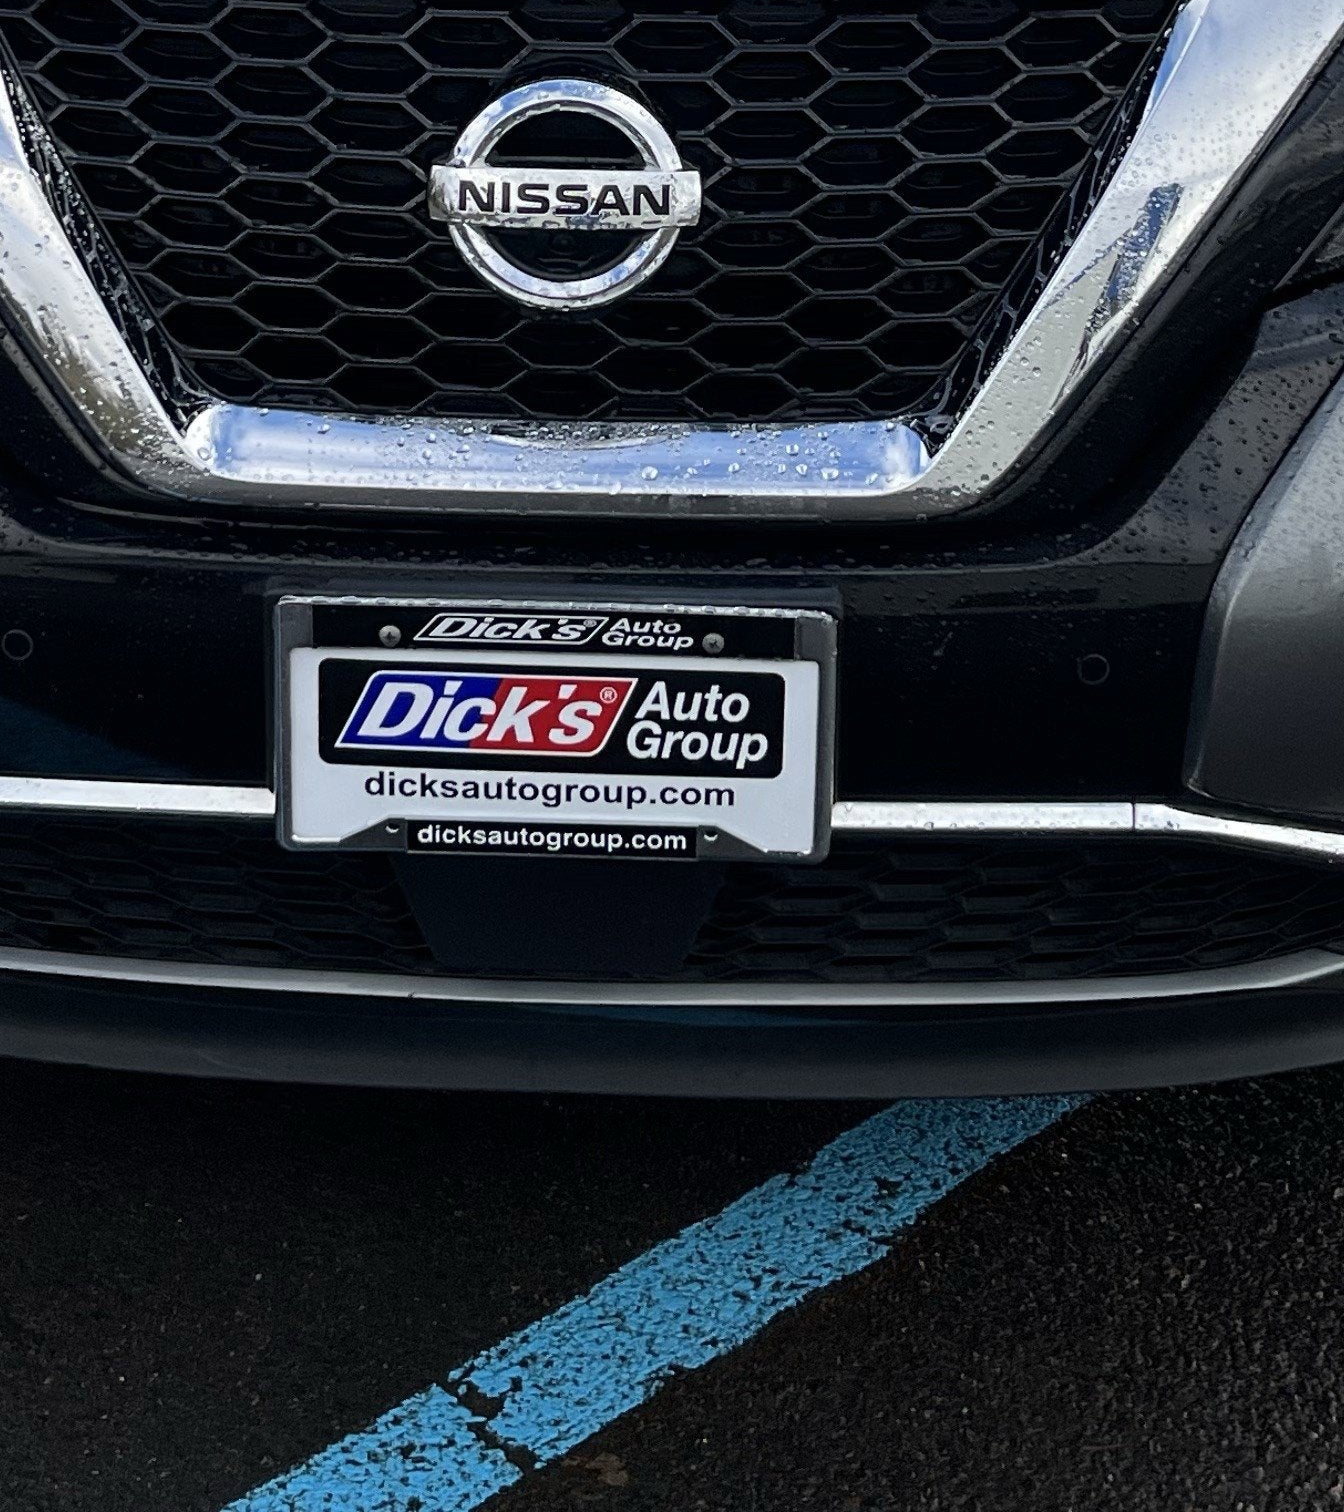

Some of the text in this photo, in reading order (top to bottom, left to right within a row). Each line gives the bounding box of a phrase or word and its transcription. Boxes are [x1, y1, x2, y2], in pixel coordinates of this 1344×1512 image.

[458, 180, 671, 216] NISSAN
[428, 617, 586, 640] Dick's
[601, 632, 694, 650] Group
[609, 618, 682, 634] Auto
[356, 680, 603, 745] Dick's
[634, 680, 750, 723] Auto
[626, 720, 769, 770] Group
[363, 771, 736, 809] dicksautogroup.com
[416, 824, 688, 852] dicksautogroup.com
